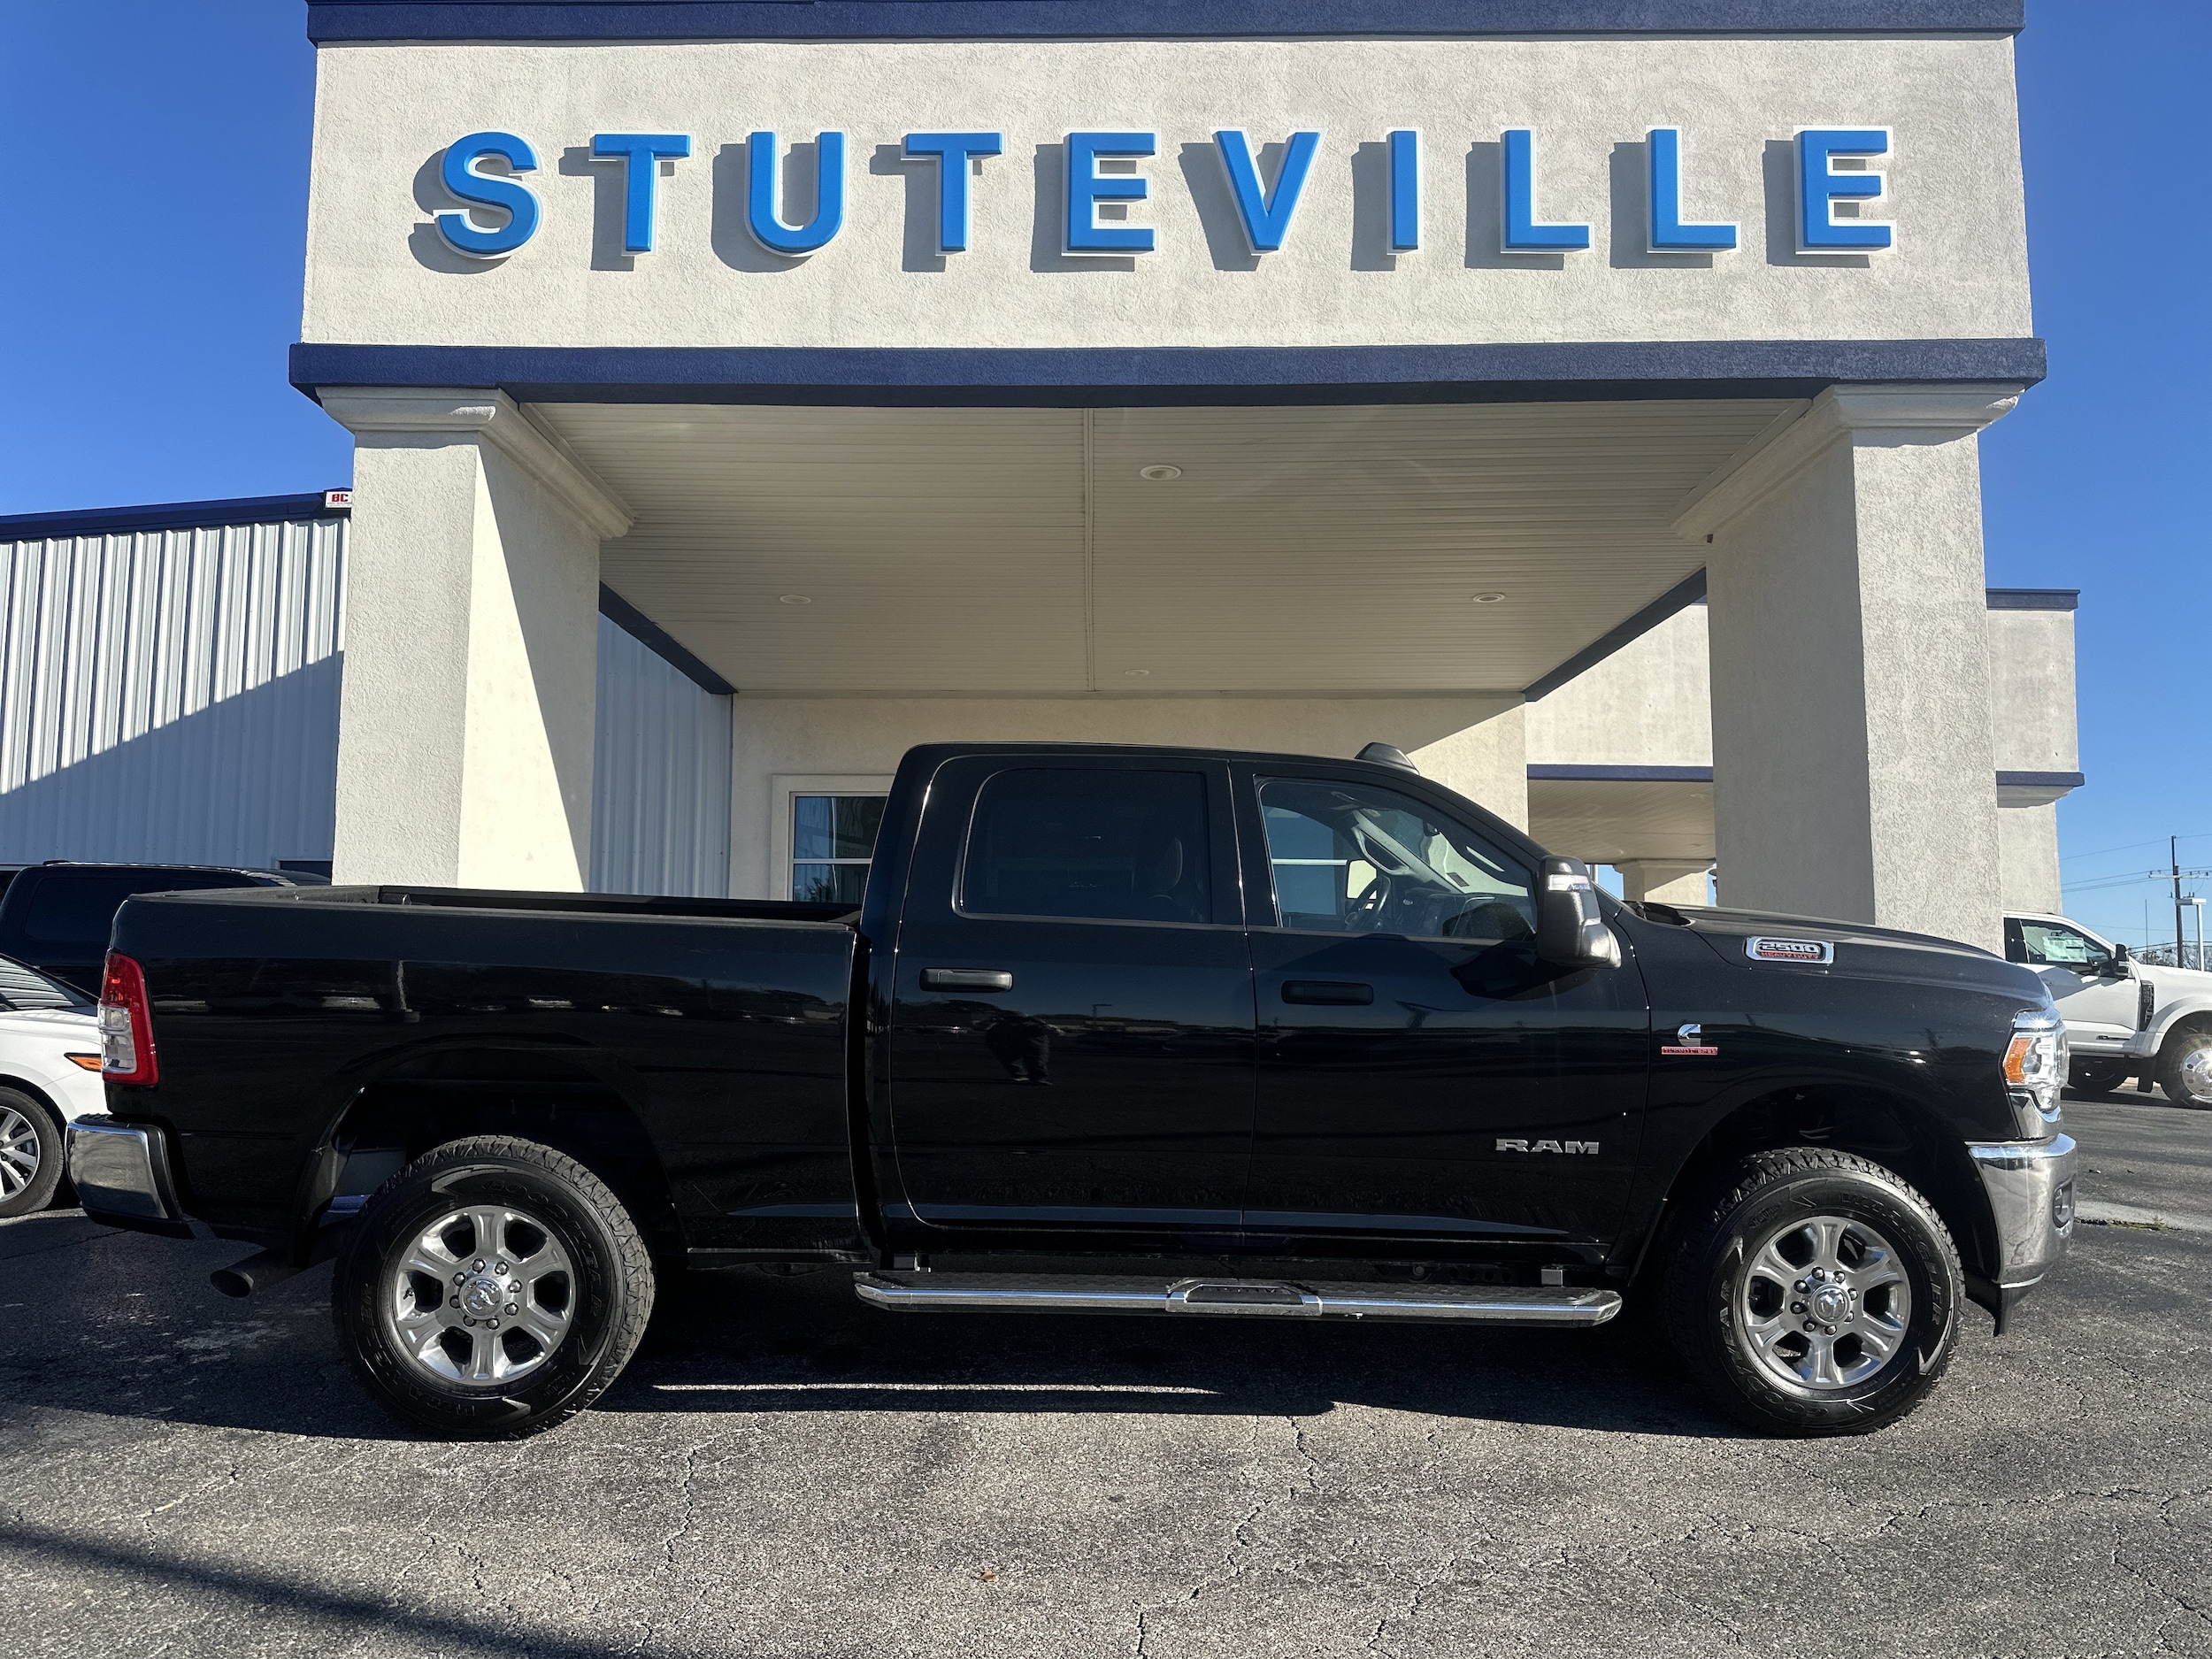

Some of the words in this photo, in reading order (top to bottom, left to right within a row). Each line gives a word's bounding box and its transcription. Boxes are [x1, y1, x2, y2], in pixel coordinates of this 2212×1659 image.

[434, 125, 1896, 258] STUTEVILLE
[1757, 941, 1820, 954] 2500
[1494, 1138, 1600, 1155] RAM
[1719, 1279, 1830, 1418] GOODYEAR
